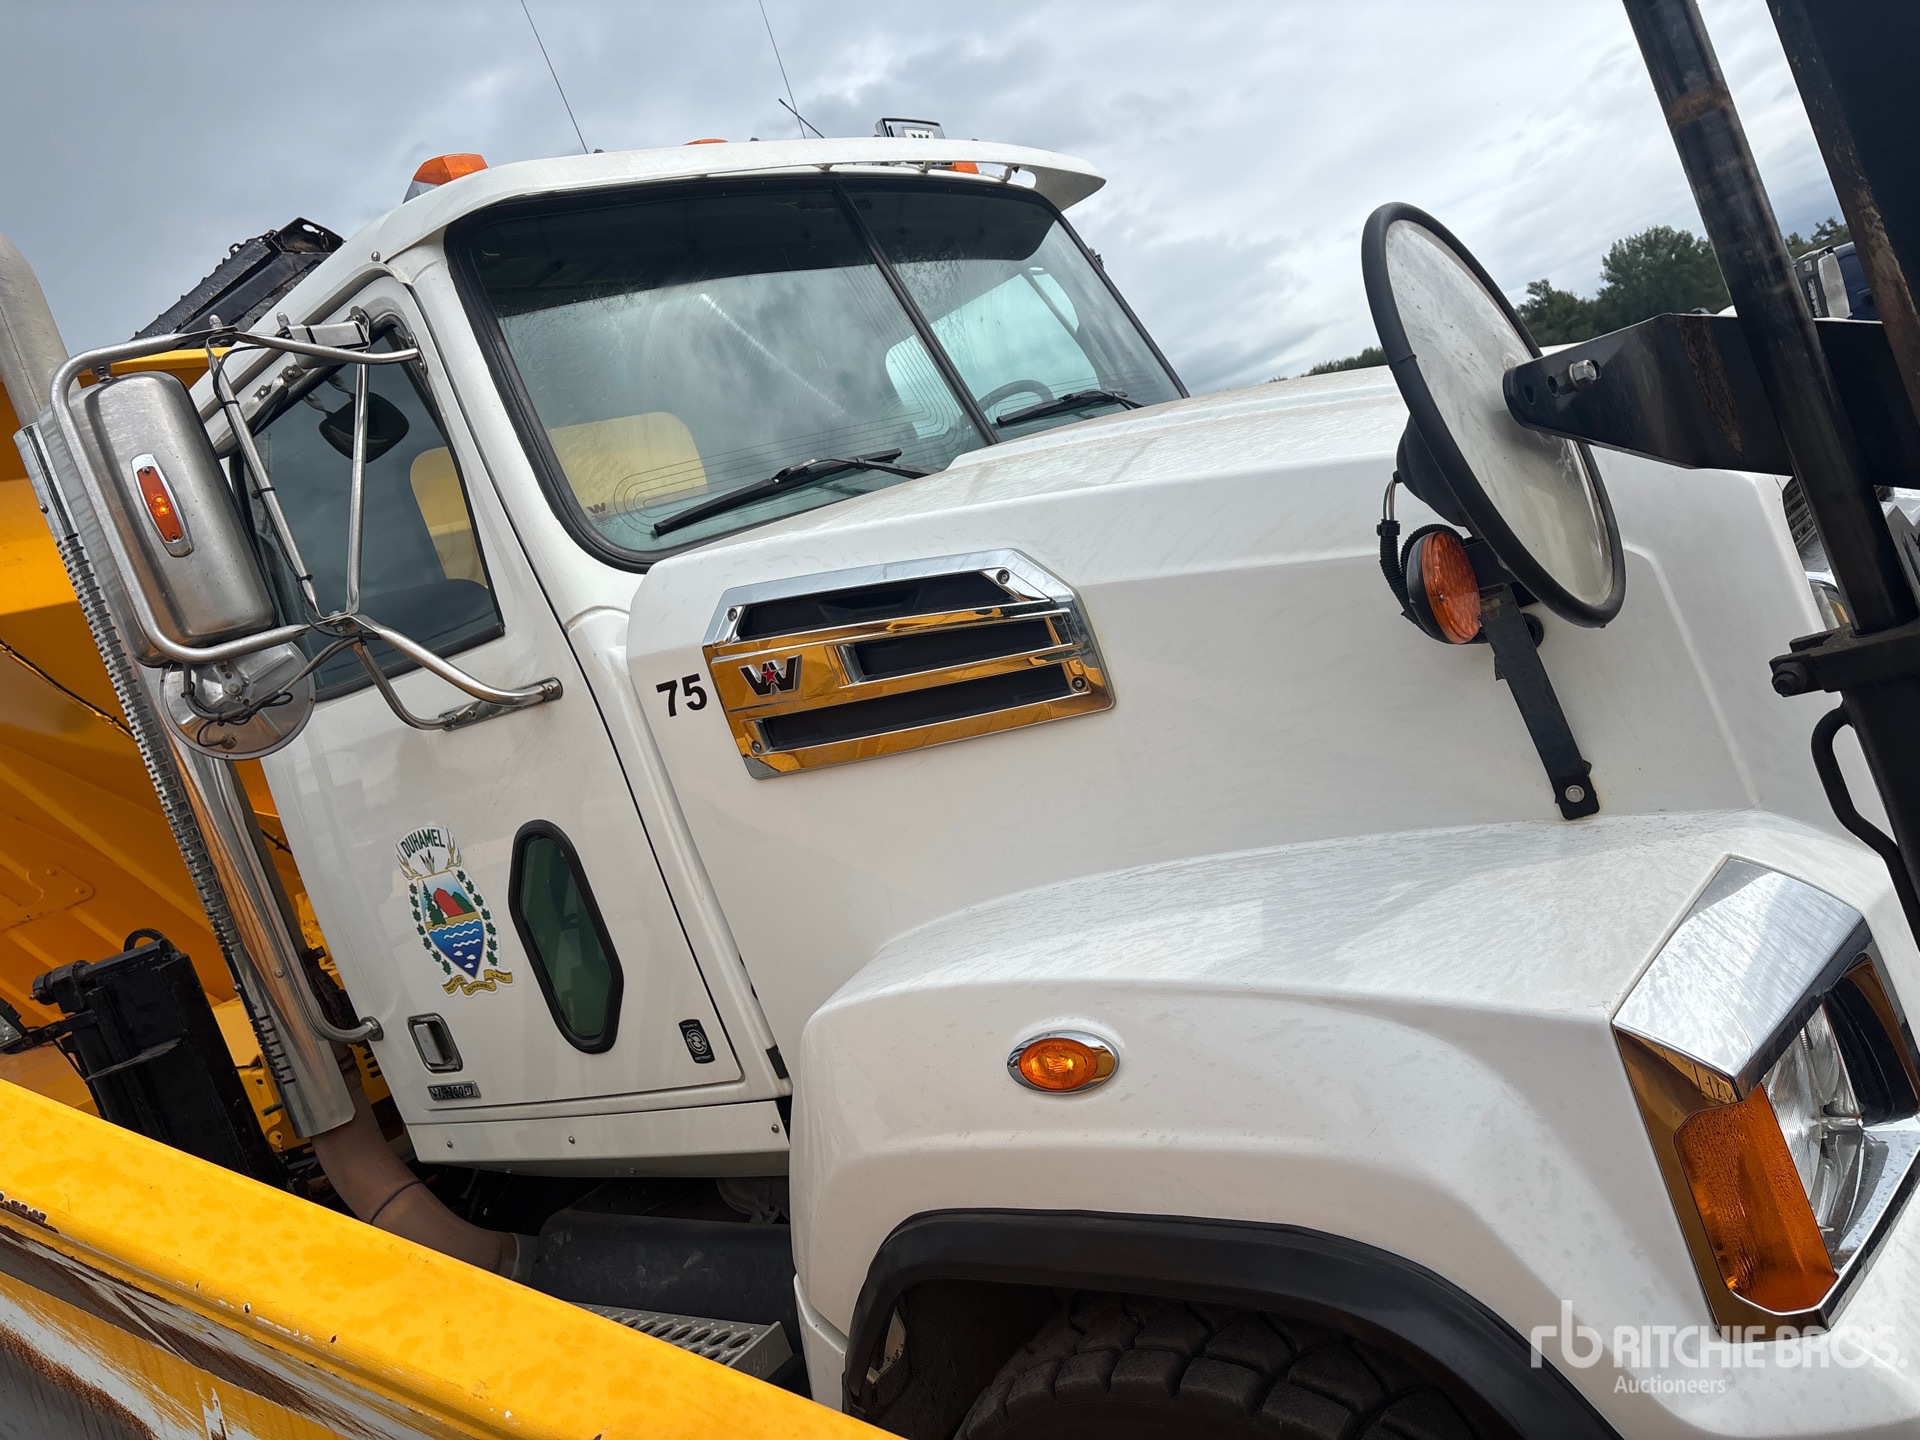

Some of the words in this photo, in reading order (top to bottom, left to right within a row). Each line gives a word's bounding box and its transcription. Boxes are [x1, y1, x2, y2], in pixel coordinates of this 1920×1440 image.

[655, 673, 708, 718] 75
[400, 828, 446, 859] DUHAMEL
[466, 982, 493, 993] DUHAMEL
